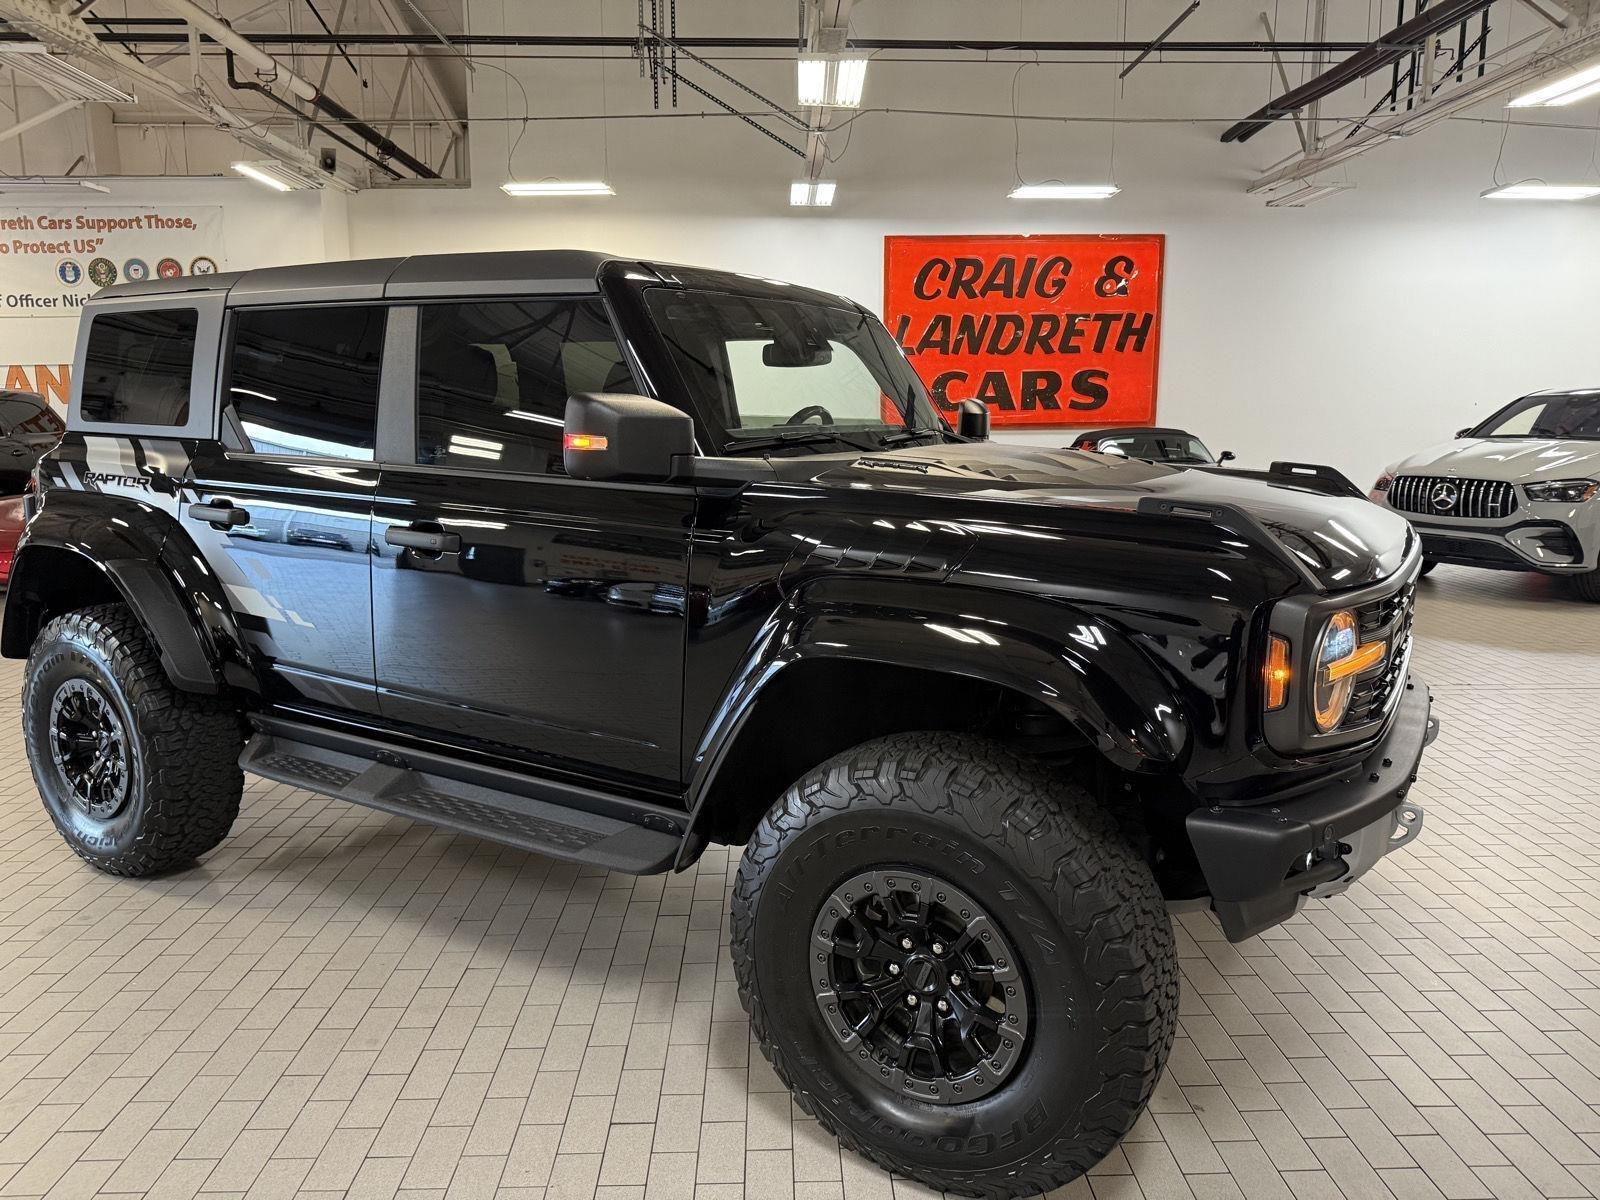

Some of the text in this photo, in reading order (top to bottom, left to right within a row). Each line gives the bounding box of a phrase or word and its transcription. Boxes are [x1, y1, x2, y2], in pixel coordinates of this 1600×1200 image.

[37, 215, 72, 230] Cars
[75, 215, 143, 233] Support
[144, 214, 197, 231] Those,
[12, 240, 71, 254] Protect
[913, 255, 1136, 300] CRAIG &
[6, 294, 58, 308] Officer
[895, 312, 1154, 356] LANDRETH
[931, 369, 1110, 412] CARS
[84, 472, 152, 493] RAPTOR
